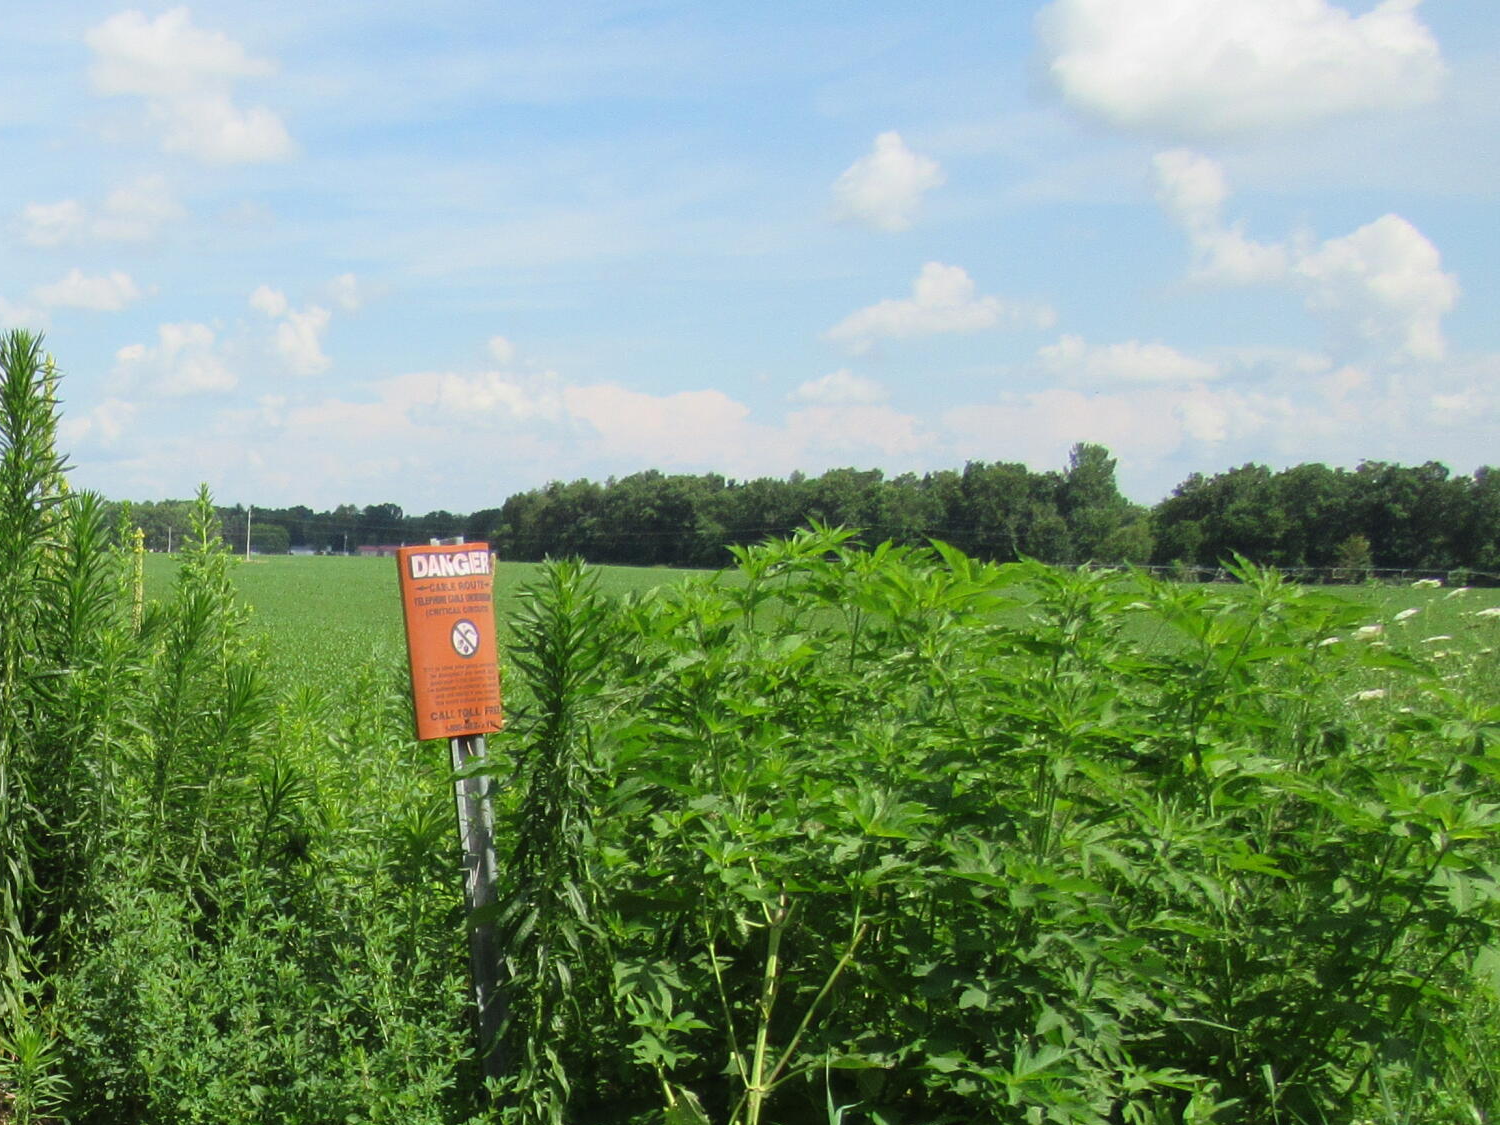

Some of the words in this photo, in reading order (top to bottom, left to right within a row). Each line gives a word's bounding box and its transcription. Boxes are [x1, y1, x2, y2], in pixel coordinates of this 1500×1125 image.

[411, 552, 490, 578] DANGER
[430, 709, 455, 720] CALL
[458, 707, 482, 718] TOLL
